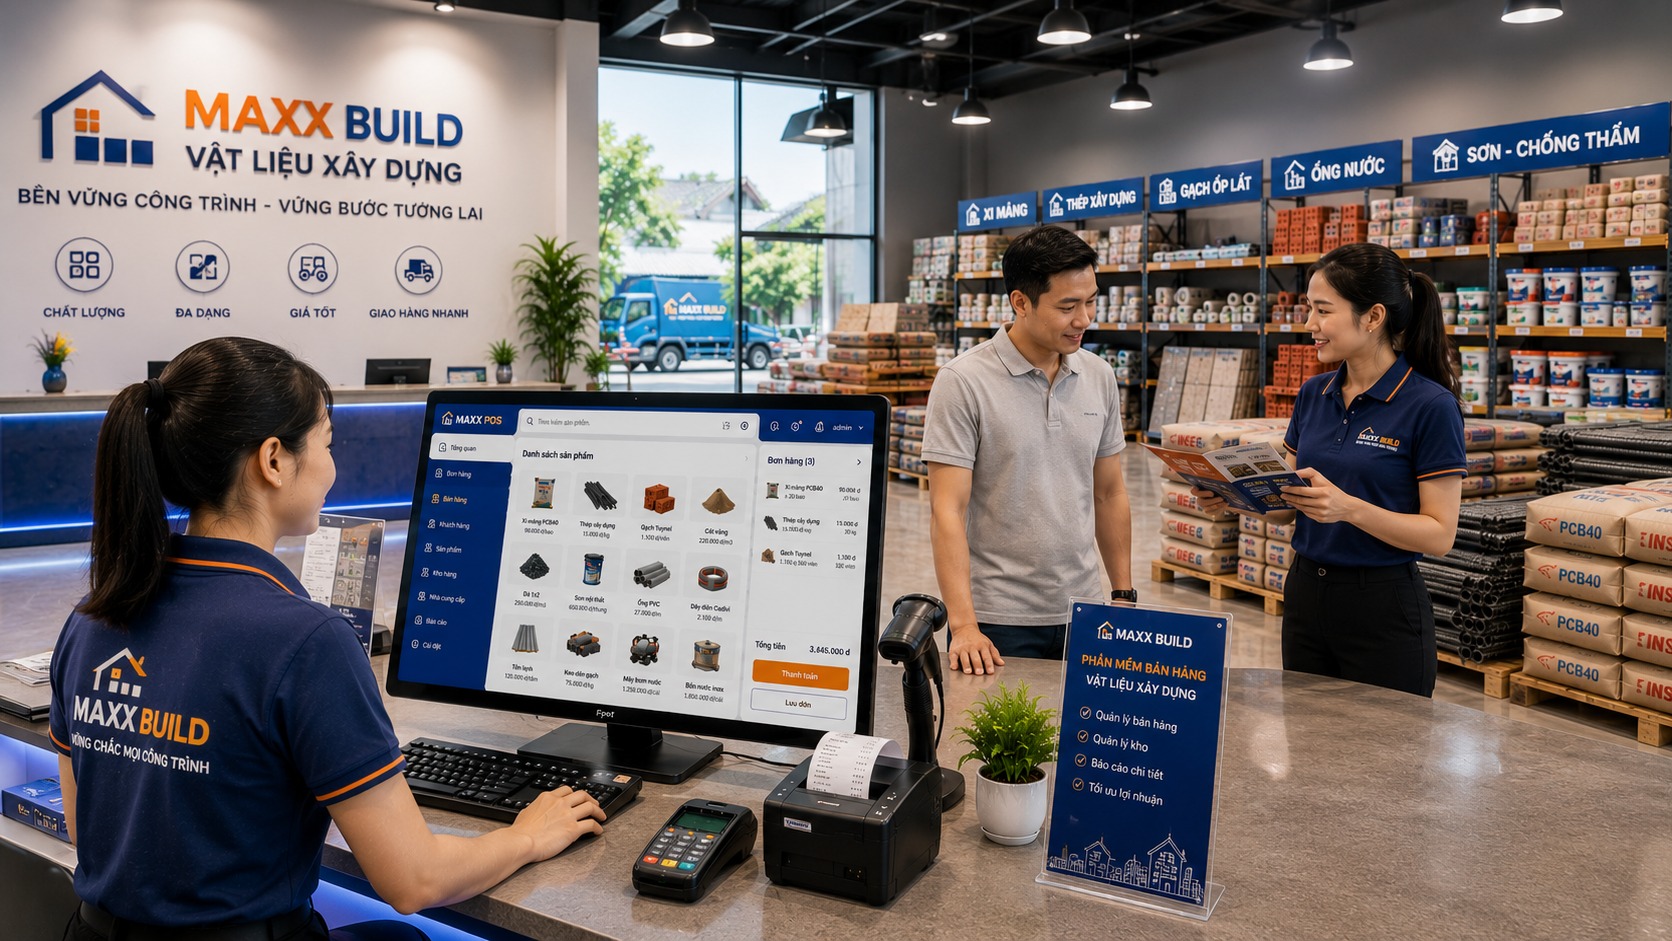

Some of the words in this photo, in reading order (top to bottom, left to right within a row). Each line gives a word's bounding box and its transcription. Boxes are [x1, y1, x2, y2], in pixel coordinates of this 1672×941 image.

[185, 89, 333, 138] MAXX
[345, 104, 464, 147] BUILD
[1466, 143, 1501, 164] SƠN
[1516, 131, 1580, 158] CHỐNG
[1584, 122, 1640, 149] THẤM
[185, 143, 242, 175] VẬT
[252, 147, 313, 179] LIỆU
[322, 152, 377, 178] XÂY
[385, 158, 462, 187] DỰNG
[1310, 159, 1341, 182] ỐNG
[1346, 156, 1385, 180] NƯỚC
[1180, 181, 1210, 200] GẠCH
[1212, 174, 1229, 194] ỐP
[18, 184, 61, 205] BỀN
[135, 190, 193, 210] CÔNG
[199, 195, 257, 212] TRÌNH
[338, 199, 388, 216] BƯỚC
[459, 206, 483, 220] LAI
[1066, 194, 1089, 212] THÉP
[1090, 191, 1109, 209] XÂY
[1109, 190, 1136, 208] DỰNG
[983, 207, 994, 221] XI
[43, 305, 78, 318] CHẤT
[82, 308, 126, 321] LƯỢNG
[175, 308, 193, 318] ĐA
[196, 308, 231, 321] DẠNG
[290, 306, 311, 319] GIÁ
[369, 309, 396, 318] GIAO
[400, 307, 429, 318] HÀNG
[432, 309, 469, 319] NHANH
[455, 415, 482, 427] MAXX
[484, 415, 503, 427] POS
[832, 423, 852, 431] admin
[522, 449, 541, 458] Danh
[805, 459, 816, 468] (3)
[1560, 521, 1602, 542] PCB40
[1559, 569, 1601, 589] PCB40
[1557, 615, 1600, 637] PCB40
[1116, 628, 1152, 643] MAXX
[1155, 633, 1193, 649] BUILD
[782, 670, 802, 680] Thanh
[1557, 659, 1599, 682] PCB40
[1162, 685, 1197, 701] DỰNG
[73, 695, 139, 733] MAXX
[139, 707, 210, 746] BUILD
[123, 745, 141, 763] MỌI
[1130, 740, 1149, 753] kho
[1130, 766, 1146, 777] chi
